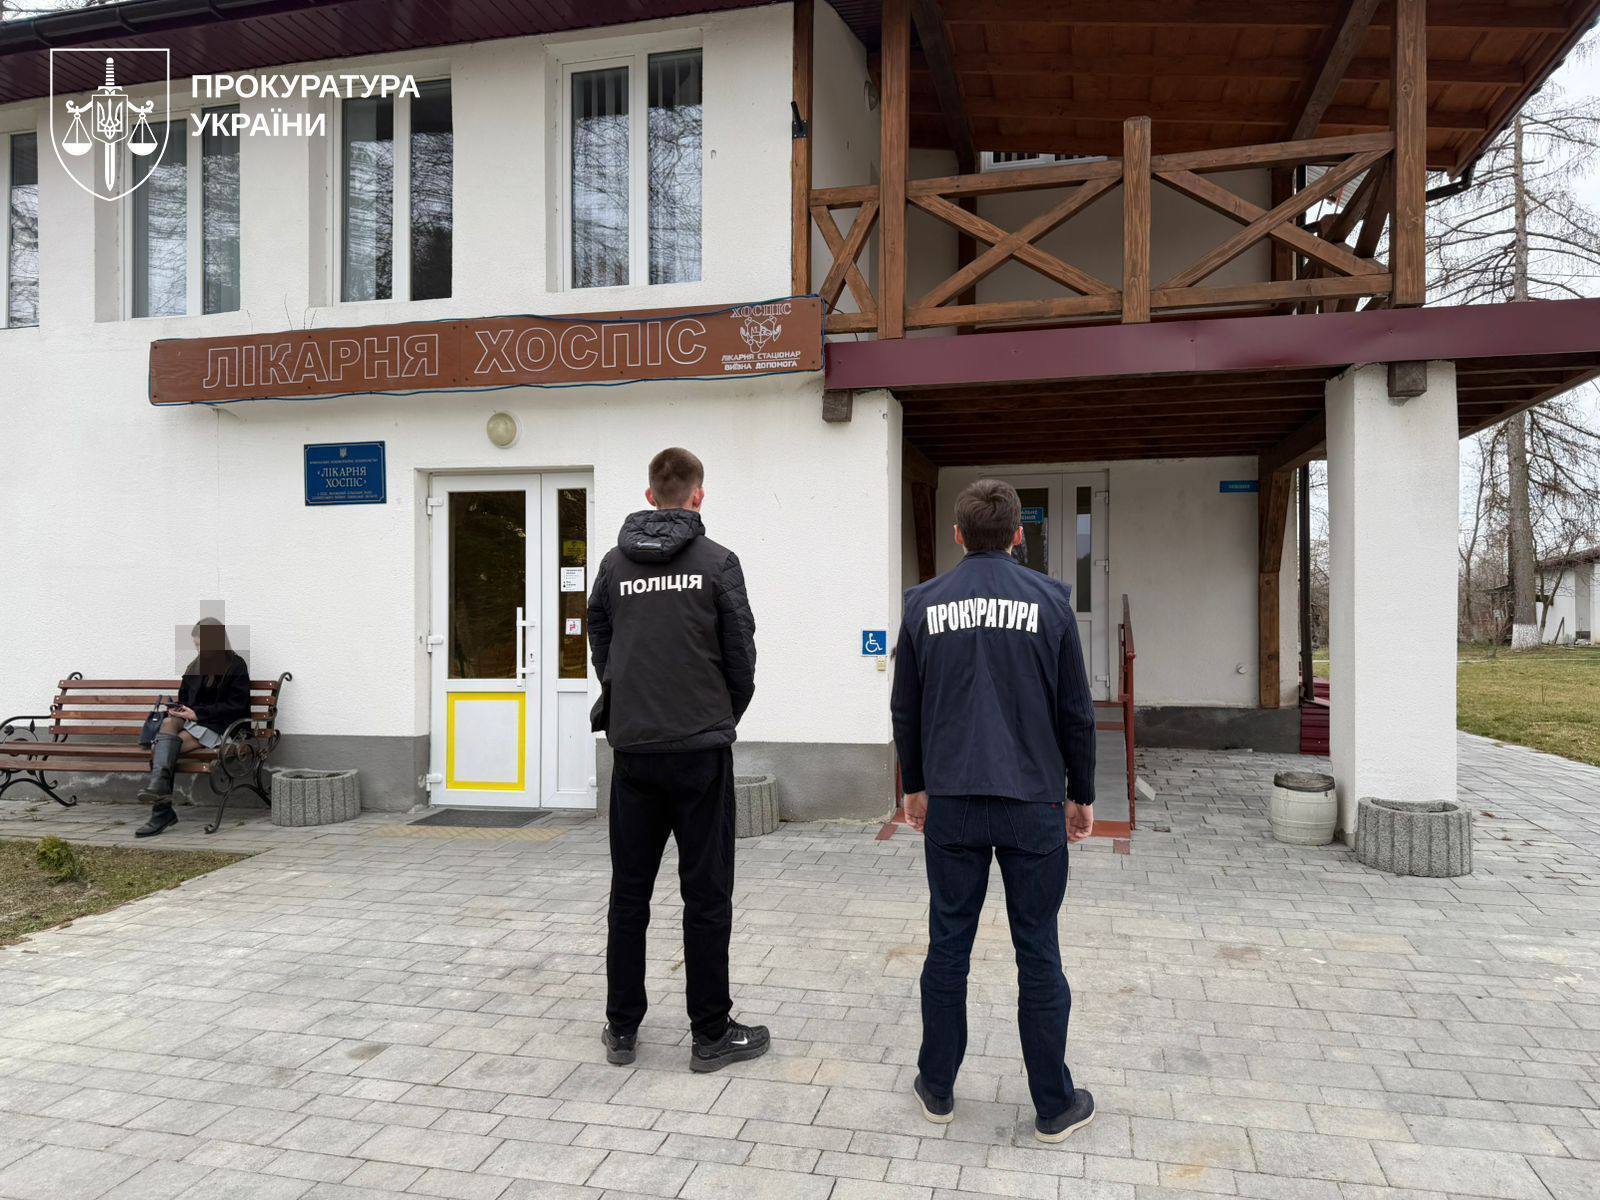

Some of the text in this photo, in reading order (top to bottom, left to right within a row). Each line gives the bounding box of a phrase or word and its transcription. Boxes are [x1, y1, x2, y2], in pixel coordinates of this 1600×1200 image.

[730, 303, 792, 318] ХОСПІС
[203, 319, 707, 389] ЛІКАРНЯ ХОСПІС
[721, 350, 801, 362] ЛІКАРНЯ СТАЦІОНАР
[755, 361, 798, 369] ДОПОМОГА
[619, 574, 703, 596] ПОЛІЦІЯ
[926, 597, 1039, 636] ПРОКУРАТУРА
